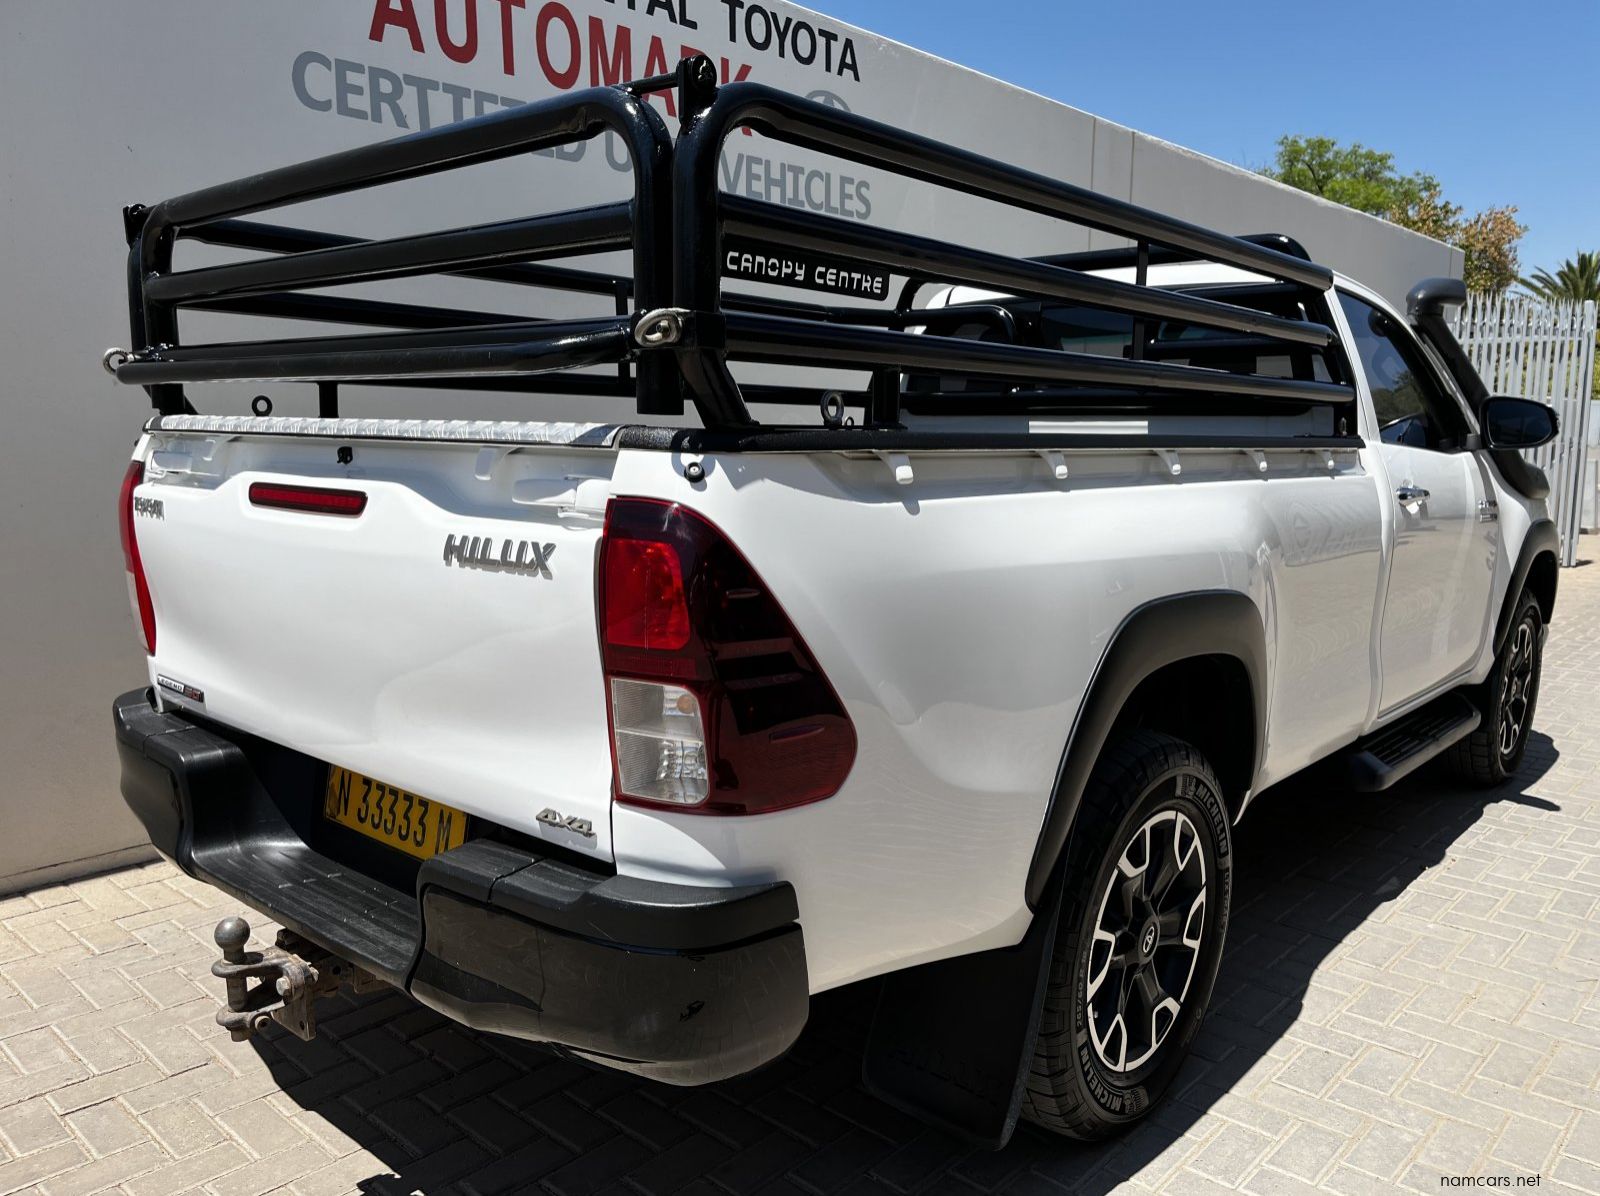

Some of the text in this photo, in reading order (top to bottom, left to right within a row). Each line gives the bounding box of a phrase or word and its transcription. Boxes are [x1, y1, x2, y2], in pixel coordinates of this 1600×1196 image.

[369, 0, 752, 137] AUTOMA
[720, 0, 861, 82] TOYOTA
[720, 150, 871, 220] VEHICLES
[727, 251, 883, 294] CANOPY CENTRE
[443, 533, 557, 580] HILUX
[337, 770, 452, 855] N 33333 M
[1196, 783, 1228, 855] MICHELIN
[1080, 1047, 1123, 1111] MICHELIN
